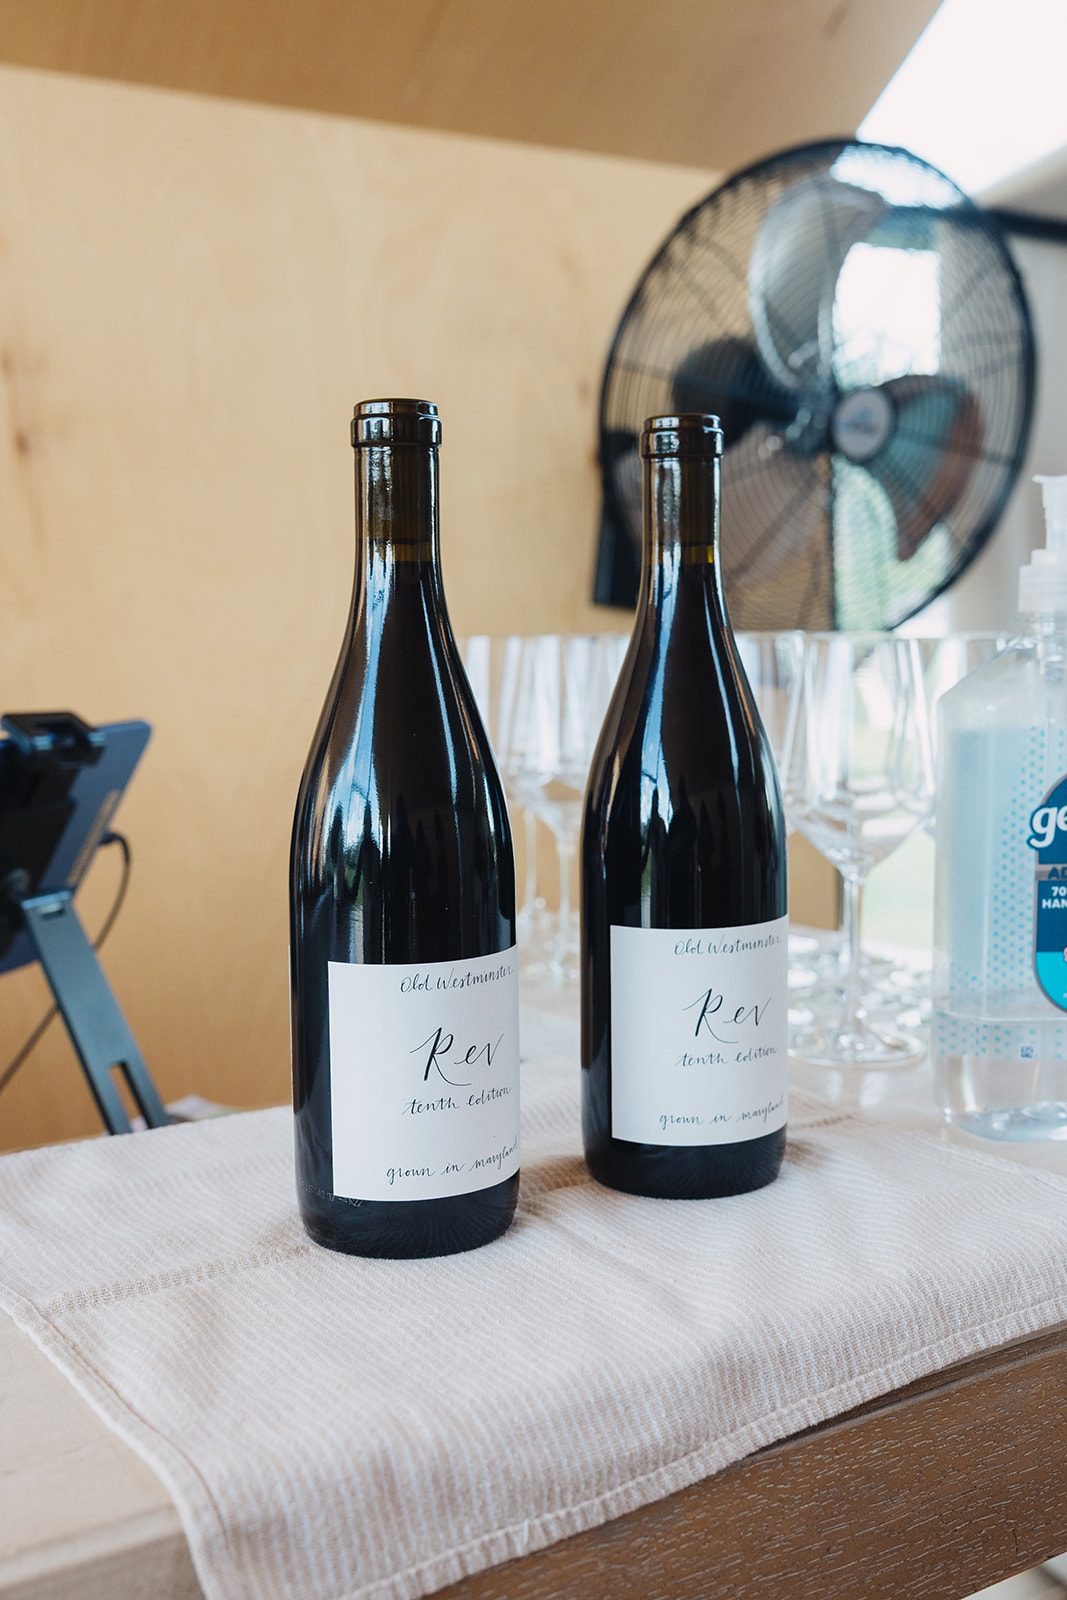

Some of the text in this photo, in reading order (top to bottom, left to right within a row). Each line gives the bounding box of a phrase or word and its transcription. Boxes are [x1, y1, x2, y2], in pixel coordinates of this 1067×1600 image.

[674, 934, 783, 956] Old Westminster
[400, 964, 515, 993] Old Westminster
[682, 988, 772, 1044] Rev
[409, 1027, 504, 1087] Rev
[673, 1046, 780, 1068] tenth edition
[401, 1086, 512, 1116] tenth edition
[659, 1112, 704, 1131] grown
[709, 1112, 732, 1125] in
[386, 1163, 436, 1186] grown
[440, 1160, 466, 1177] in
